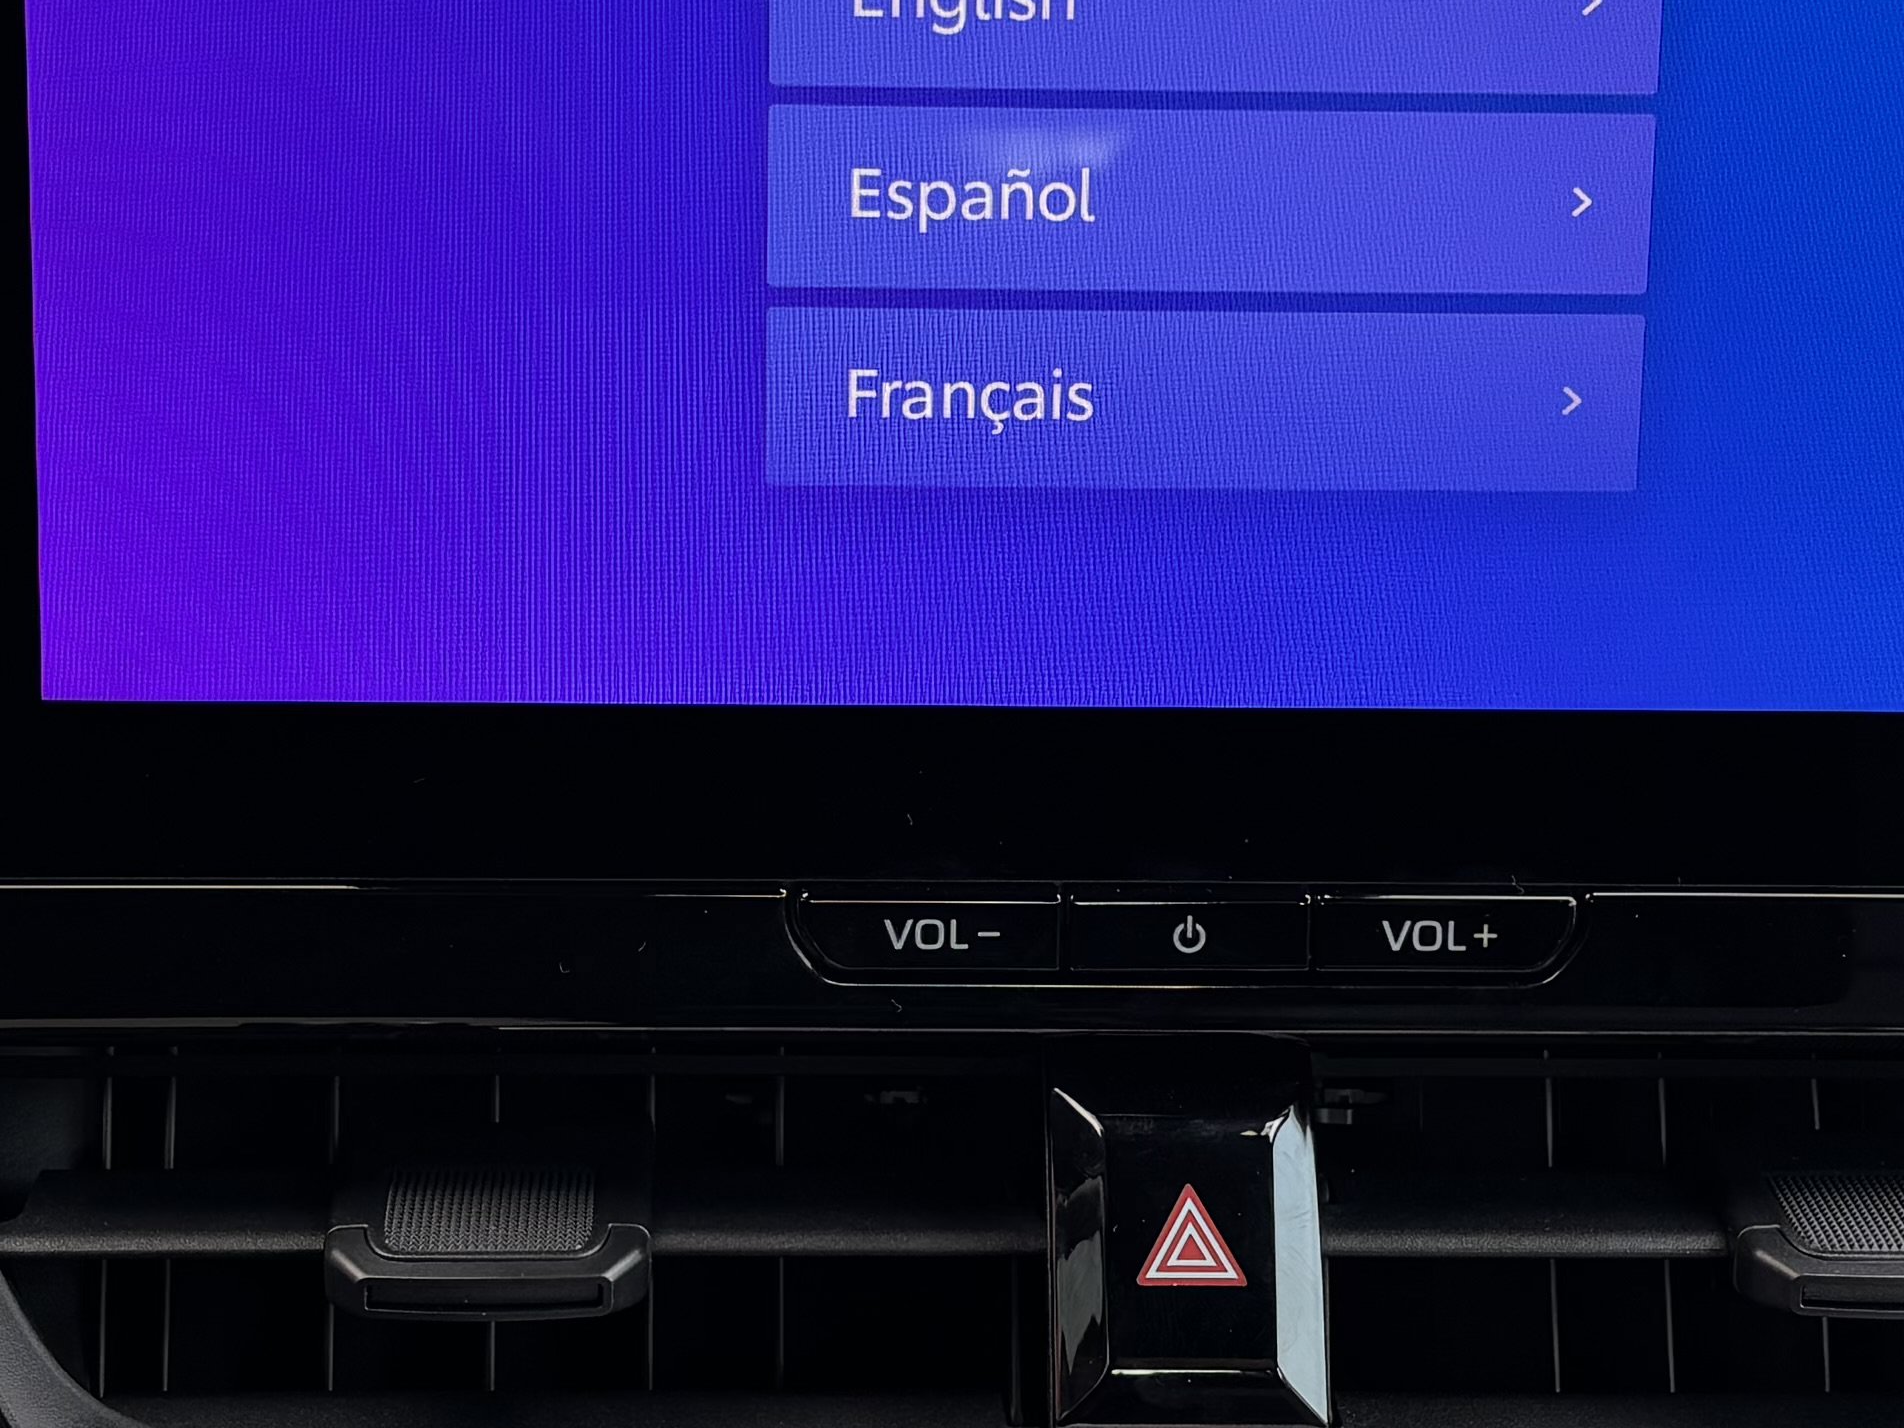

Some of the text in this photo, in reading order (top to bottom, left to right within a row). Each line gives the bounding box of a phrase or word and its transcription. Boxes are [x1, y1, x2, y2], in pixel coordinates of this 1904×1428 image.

[851, 167, 1096, 234] Español
[848, 368, 1095, 435] Français
[1382, 920, 1498, 953] VOL+
